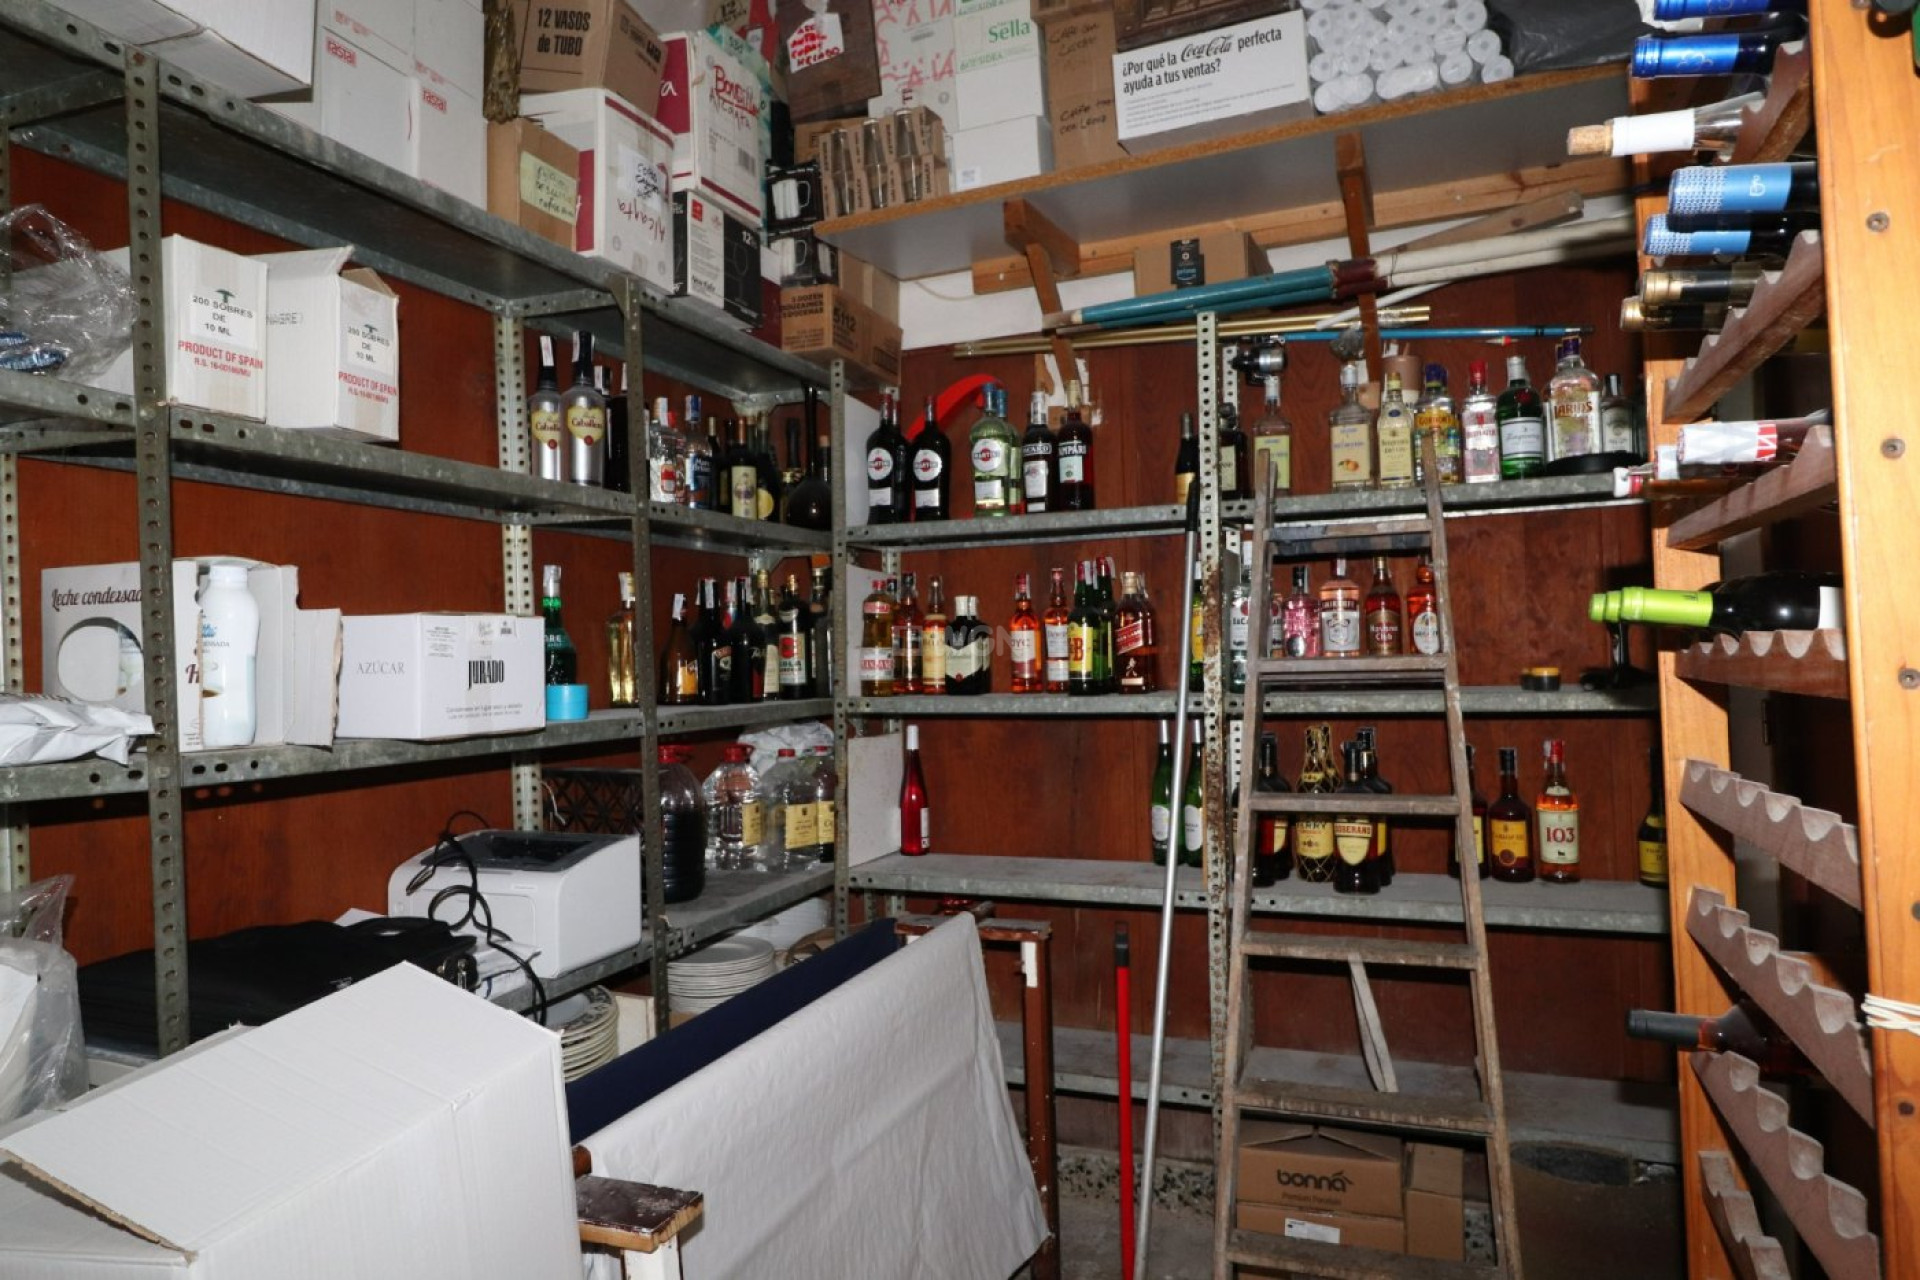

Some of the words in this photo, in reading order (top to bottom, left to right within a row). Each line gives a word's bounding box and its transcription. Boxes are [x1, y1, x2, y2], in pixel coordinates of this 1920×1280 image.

[538, 10, 551, 28] 12
[554, 10, 591, 31] VASOS
[537, 34, 550, 52] de
[554, 35, 583, 56] TUBO
[1122, 62, 1144, 77] ¿Por
[1146, 53, 1165, 72] qué
[1167, 52, 1177, 67] la
[1238, 28, 1282, 52] perfecta
[1123, 74, 1153, 96] ayuda
[1155, 75, 1162, 87] a
[1164, 70, 1180, 85] tus
[1182, 58, 1222, 80] ventas?
[193, 294, 210, 306] 200
[212, 300, 254, 319] SOBRES
[212, 312, 226, 323] DE
[205, 323, 216, 332] 10
[218, 326, 232, 336] ML
[361, 331, 390, 347] SOBRES
[178, 340, 223, 359] PRODUCT
[225, 351, 237, 363] OF
[238, 355, 263, 370] SPAIN
[361, 342, 372, 351] DE
[338, 371, 369, 389] PRODUCT
[370, 380, 379, 391] OF
[380, 383, 397, 396] SPAIN
[1554, 402, 1592, 418] LARIOS
[51, 588, 80, 612] Leche
[356, 660, 405, 675] AZÚCAR
[468, 660, 505, 690] JURADO
[1545, 827, 1576, 844] 103
